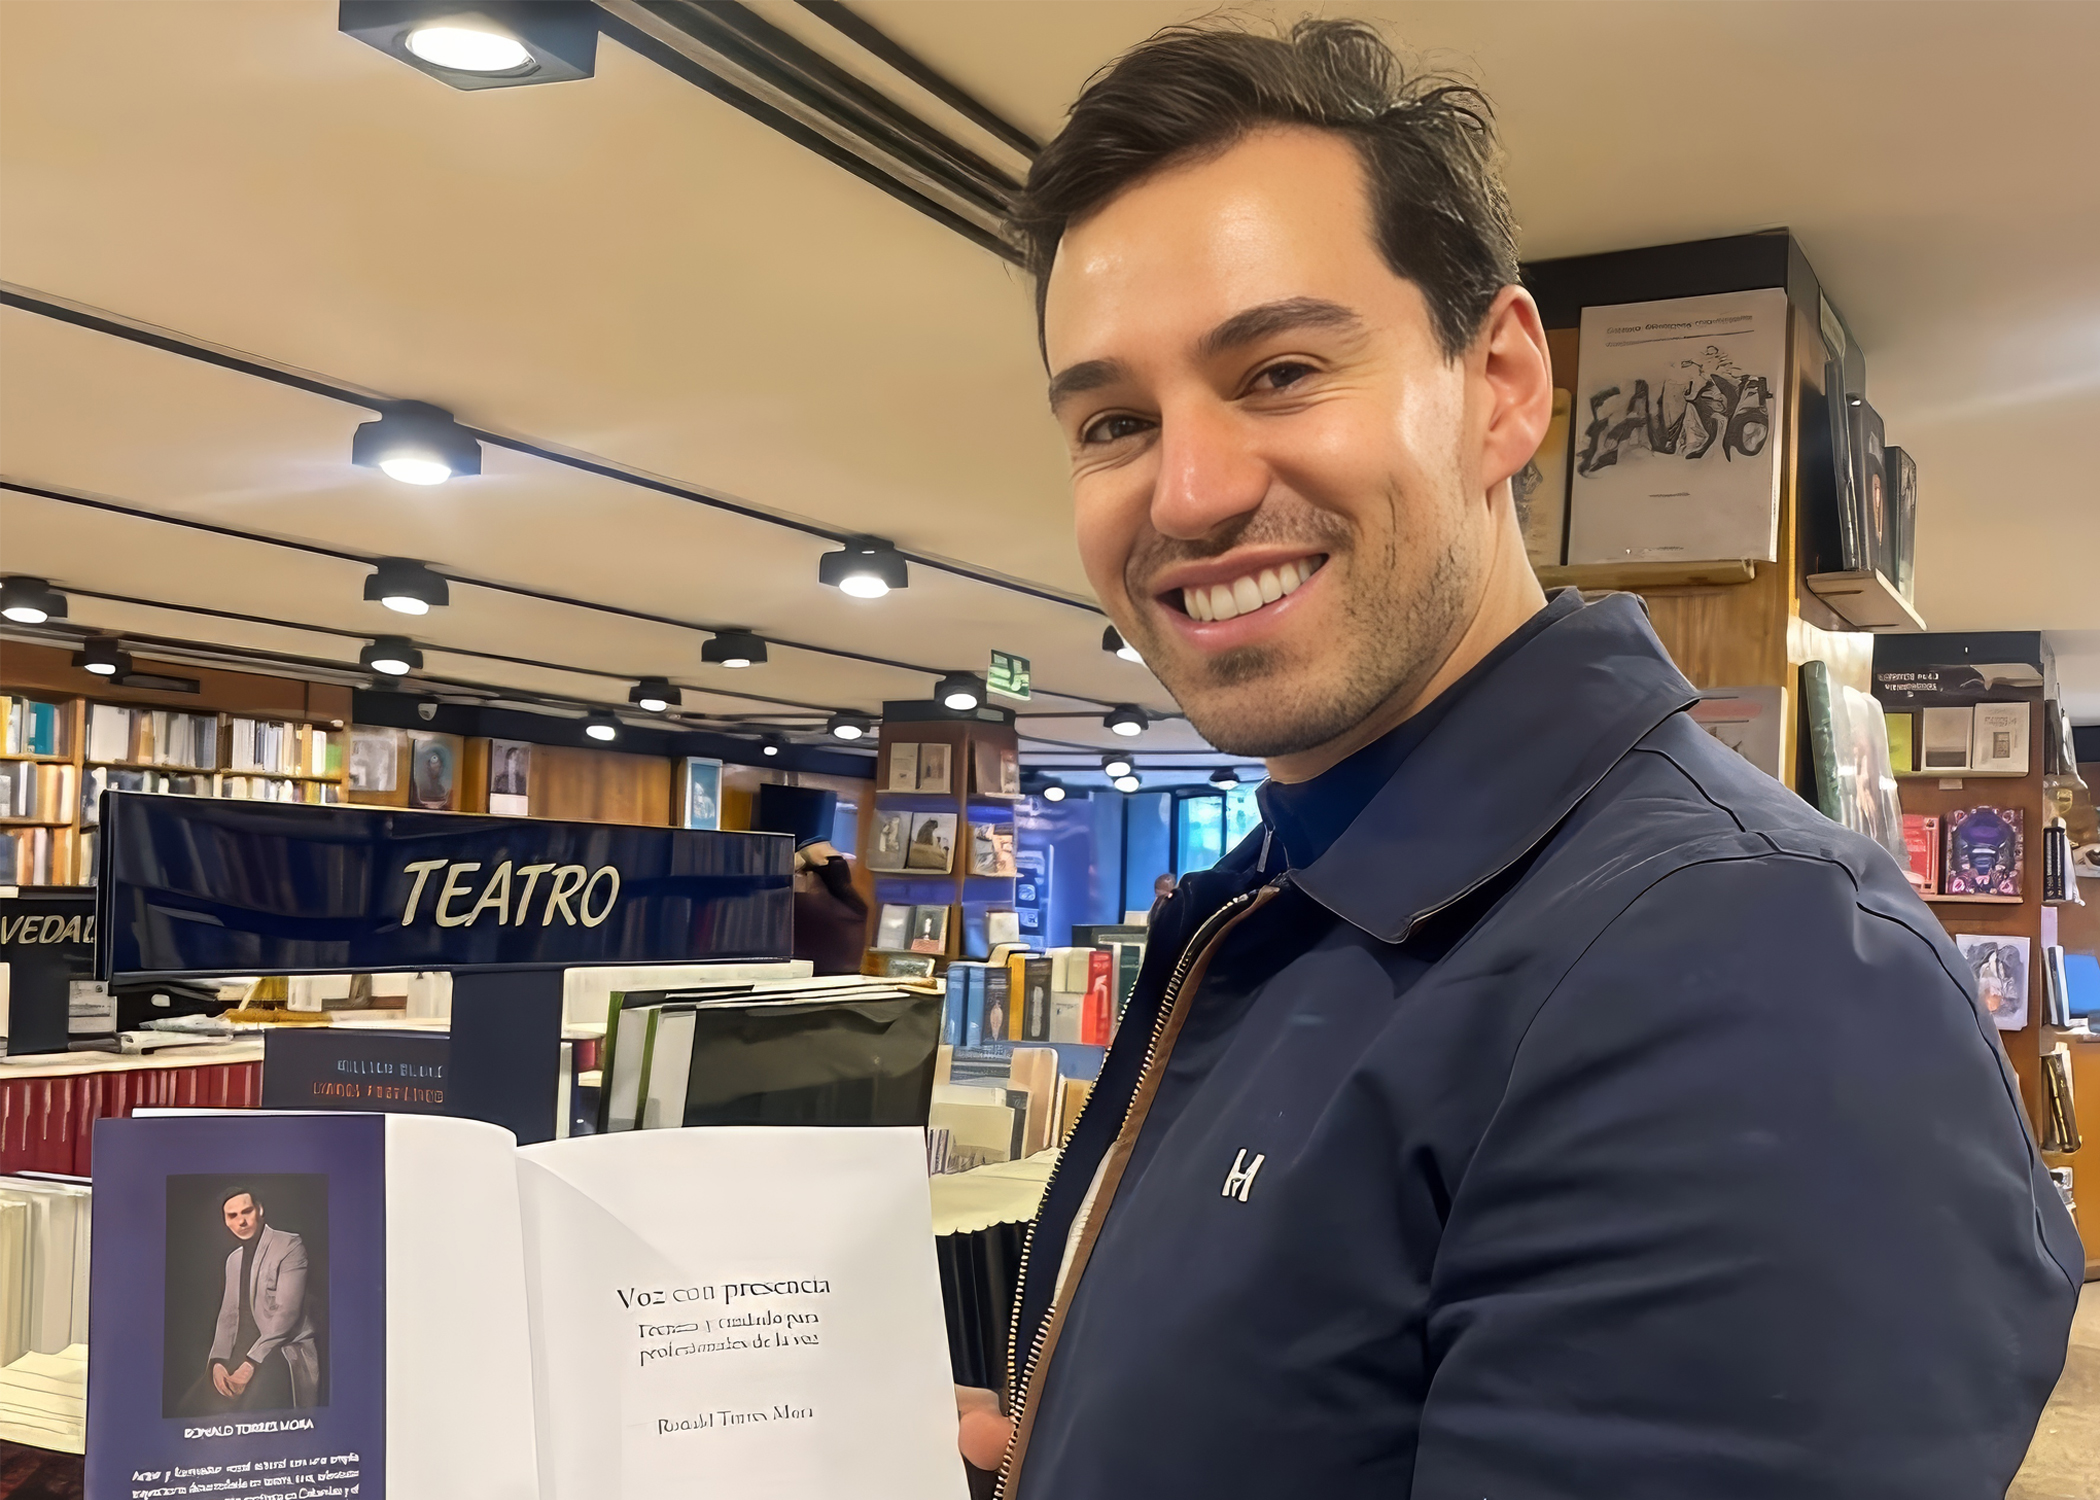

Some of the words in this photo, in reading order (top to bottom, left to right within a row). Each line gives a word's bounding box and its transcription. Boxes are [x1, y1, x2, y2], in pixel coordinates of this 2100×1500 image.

[400, 859, 622, 928] TEATRO
[616, 1287, 666, 1309] Voz
[672, 1286, 715, 1303] con
[722, 1276, 830, 1305] presencia
